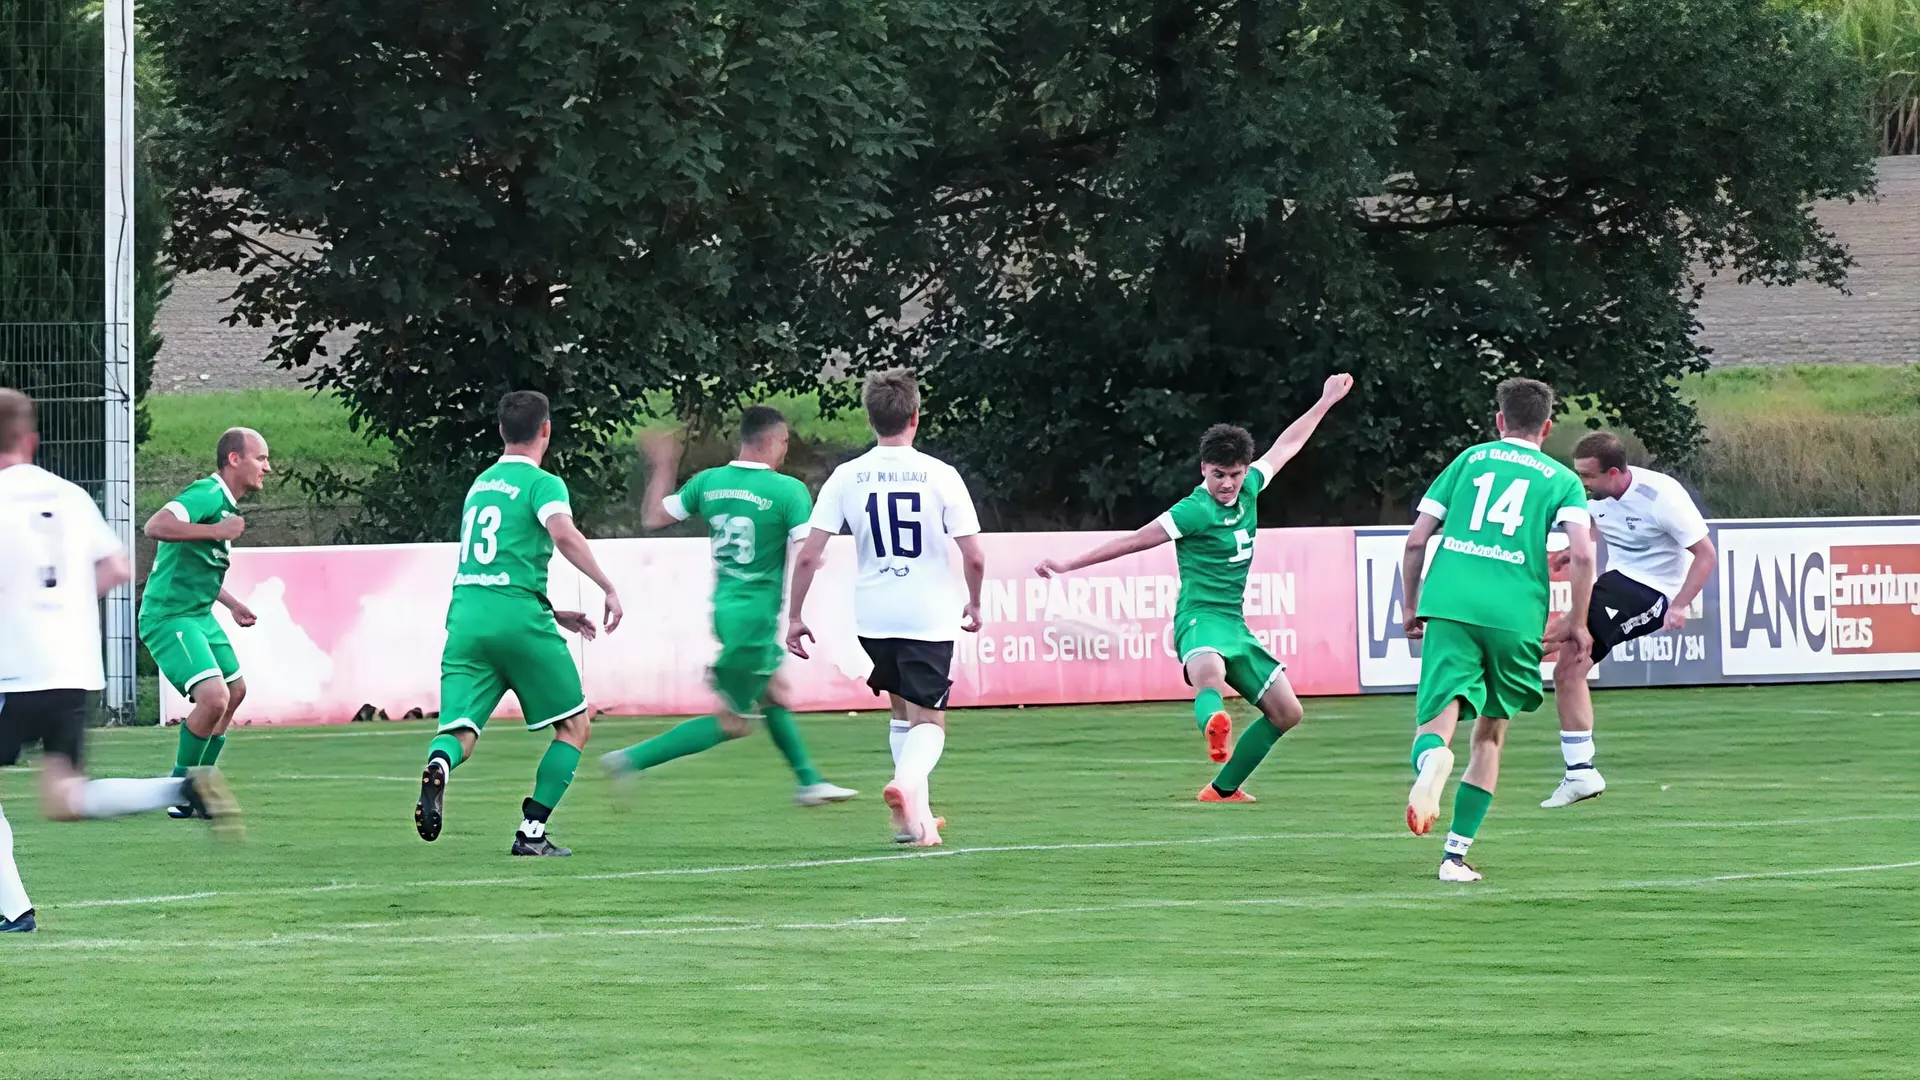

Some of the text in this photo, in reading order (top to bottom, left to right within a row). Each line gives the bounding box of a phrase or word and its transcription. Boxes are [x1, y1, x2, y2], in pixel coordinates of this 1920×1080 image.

[461, 505, 501, 565] 13
[865, 492, 922, 558] 16
[1469, 472, 1530, 536] 14
[1025, 575, 1178, 621] PARTNER
[1366, 558, 1422, 658] LA
[1728, 550, 1826, 652] LANG
[1002, 635, 1036, 663] an
[1042, 626, 1110, 662] Seite
